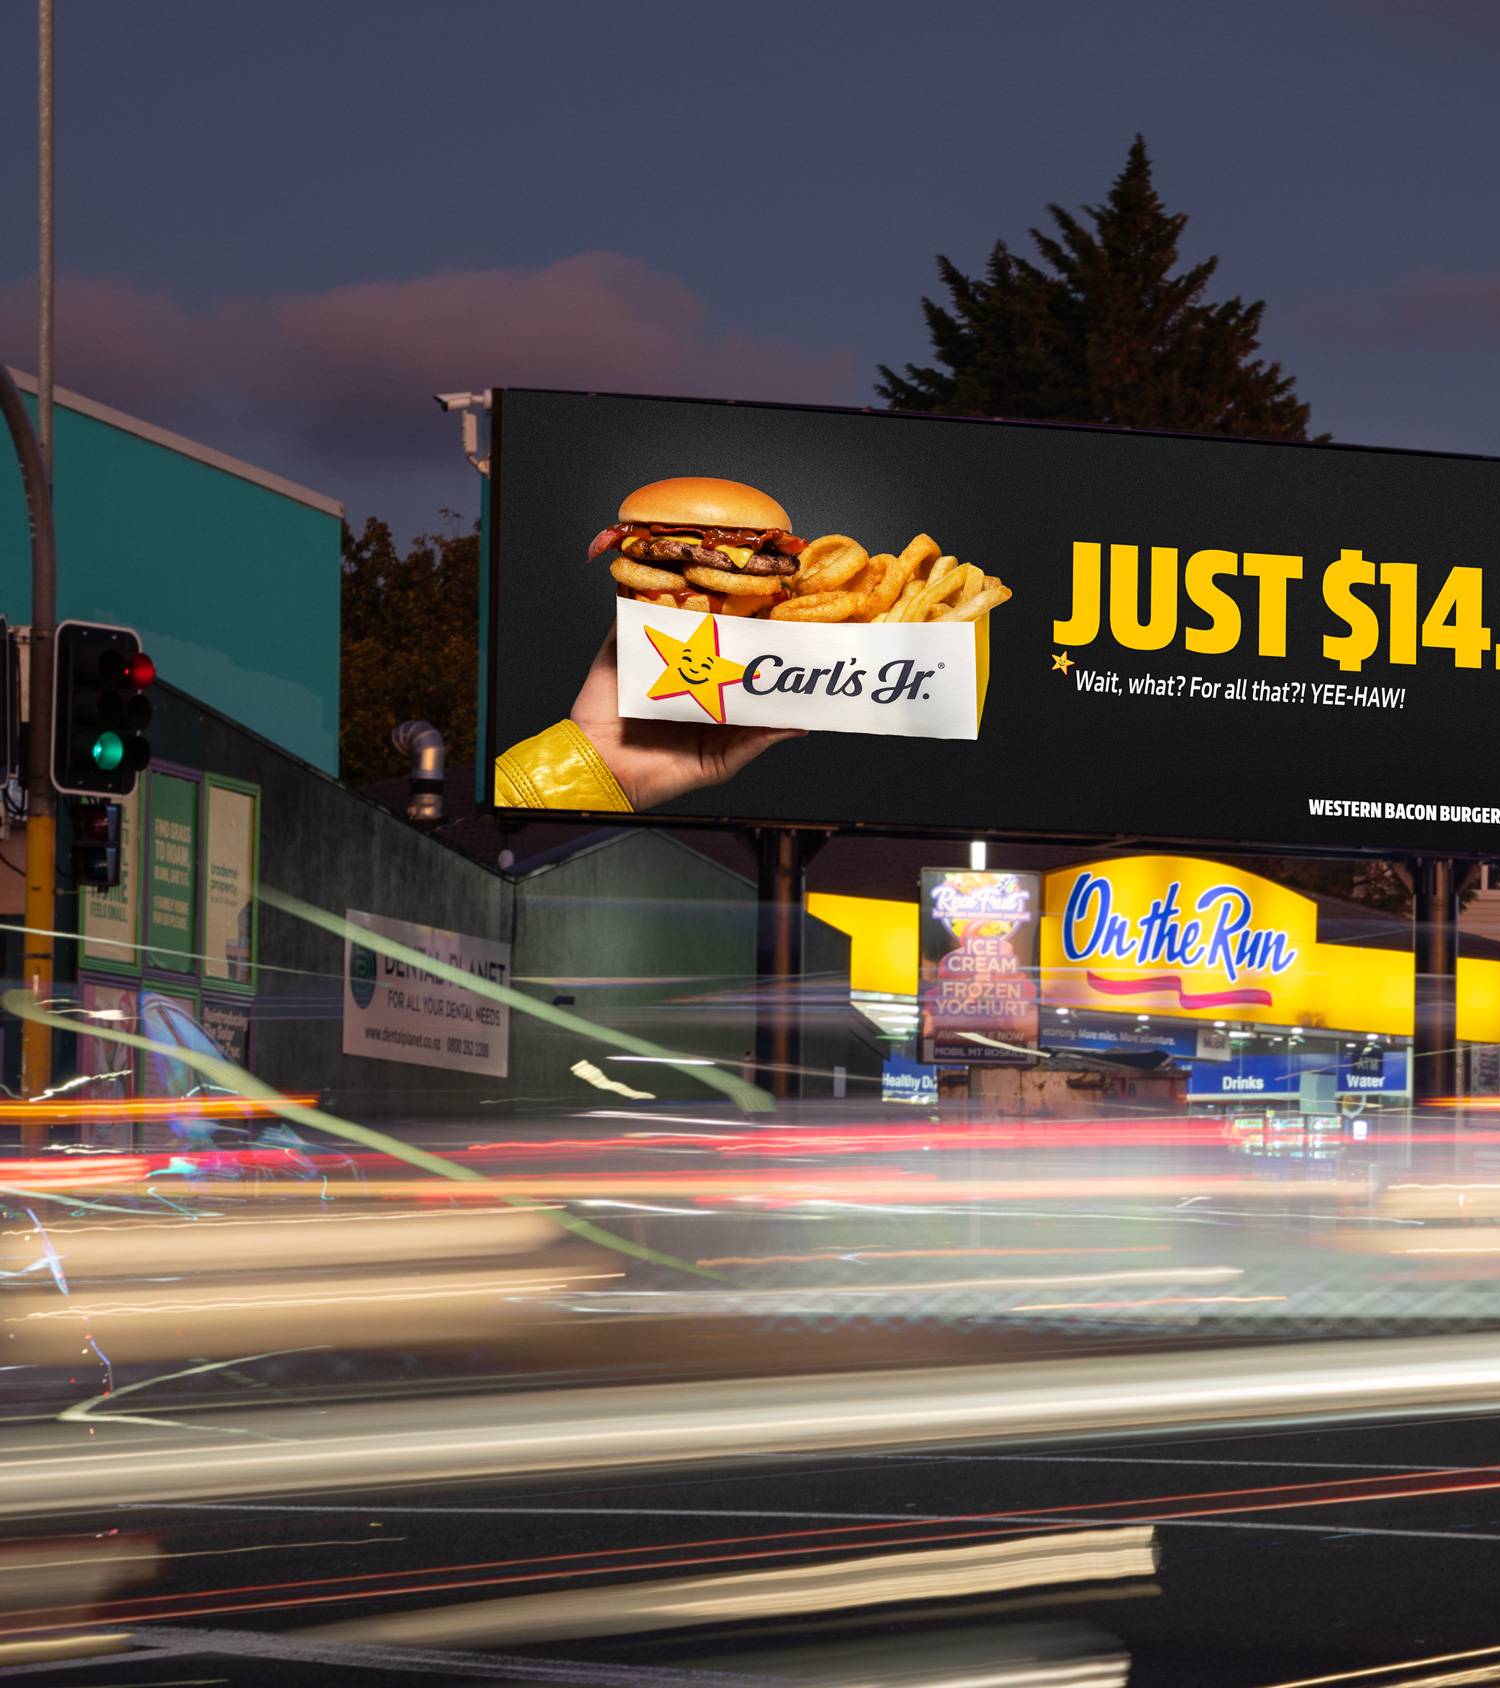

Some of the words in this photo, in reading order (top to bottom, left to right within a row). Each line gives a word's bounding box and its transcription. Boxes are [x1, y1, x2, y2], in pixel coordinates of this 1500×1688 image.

[1053, 541, 1303, 657] JUST
[742, 654, 866, 698] Carl's
[871, 659, 936, 705] Jr.
[1075, 670, 1122, 695] Wait,
[1129, 674, 1186, 697] what?
[1190, 677, 1221, 698] For
[1225, 679, 1247, 700] all
[1252, 680, 1305, 703] that?!
[1311, 683, 1406, 709] YEE-HAW!
[1309, 799, 1382, 819] WESTERN
[1385, 803, 1437, 821] BACON
[1440, 805, 1500, 825] BURGER
[1063, 872, 1137, 961] On
[1137, 881, 1205, 967] the
[1197, 885, 1298, 982] Run
[966, 938, 998, 956] ICE
[948, 956, 1016, 973] CREAM
[942, 981, 1021, 998] FROZEN
[388, 990, 404, 1008] FOR
[406, 993, 421, 1012] ALL
[423, 995, 444, 1016] YOUR
[446, 1001, 473, 1021] DENTAL
[475, 1006, 501, 1026] NEEDS
[935, 998, 1029, 1016] YOGHURT
[365, 1026, 441, 1050] www.dentalplanet.co.nz
[997, 1031, 1025, 1041] NOW
[1078, 1029, 1097, 1040] More
[934, 1047, 966, 1057] MOBIL
[968, 1048, 984, 1057] MT
[1222, 1076, 1264, 1091] Drinks
[1347, 1074, 1386, 1089] Water
